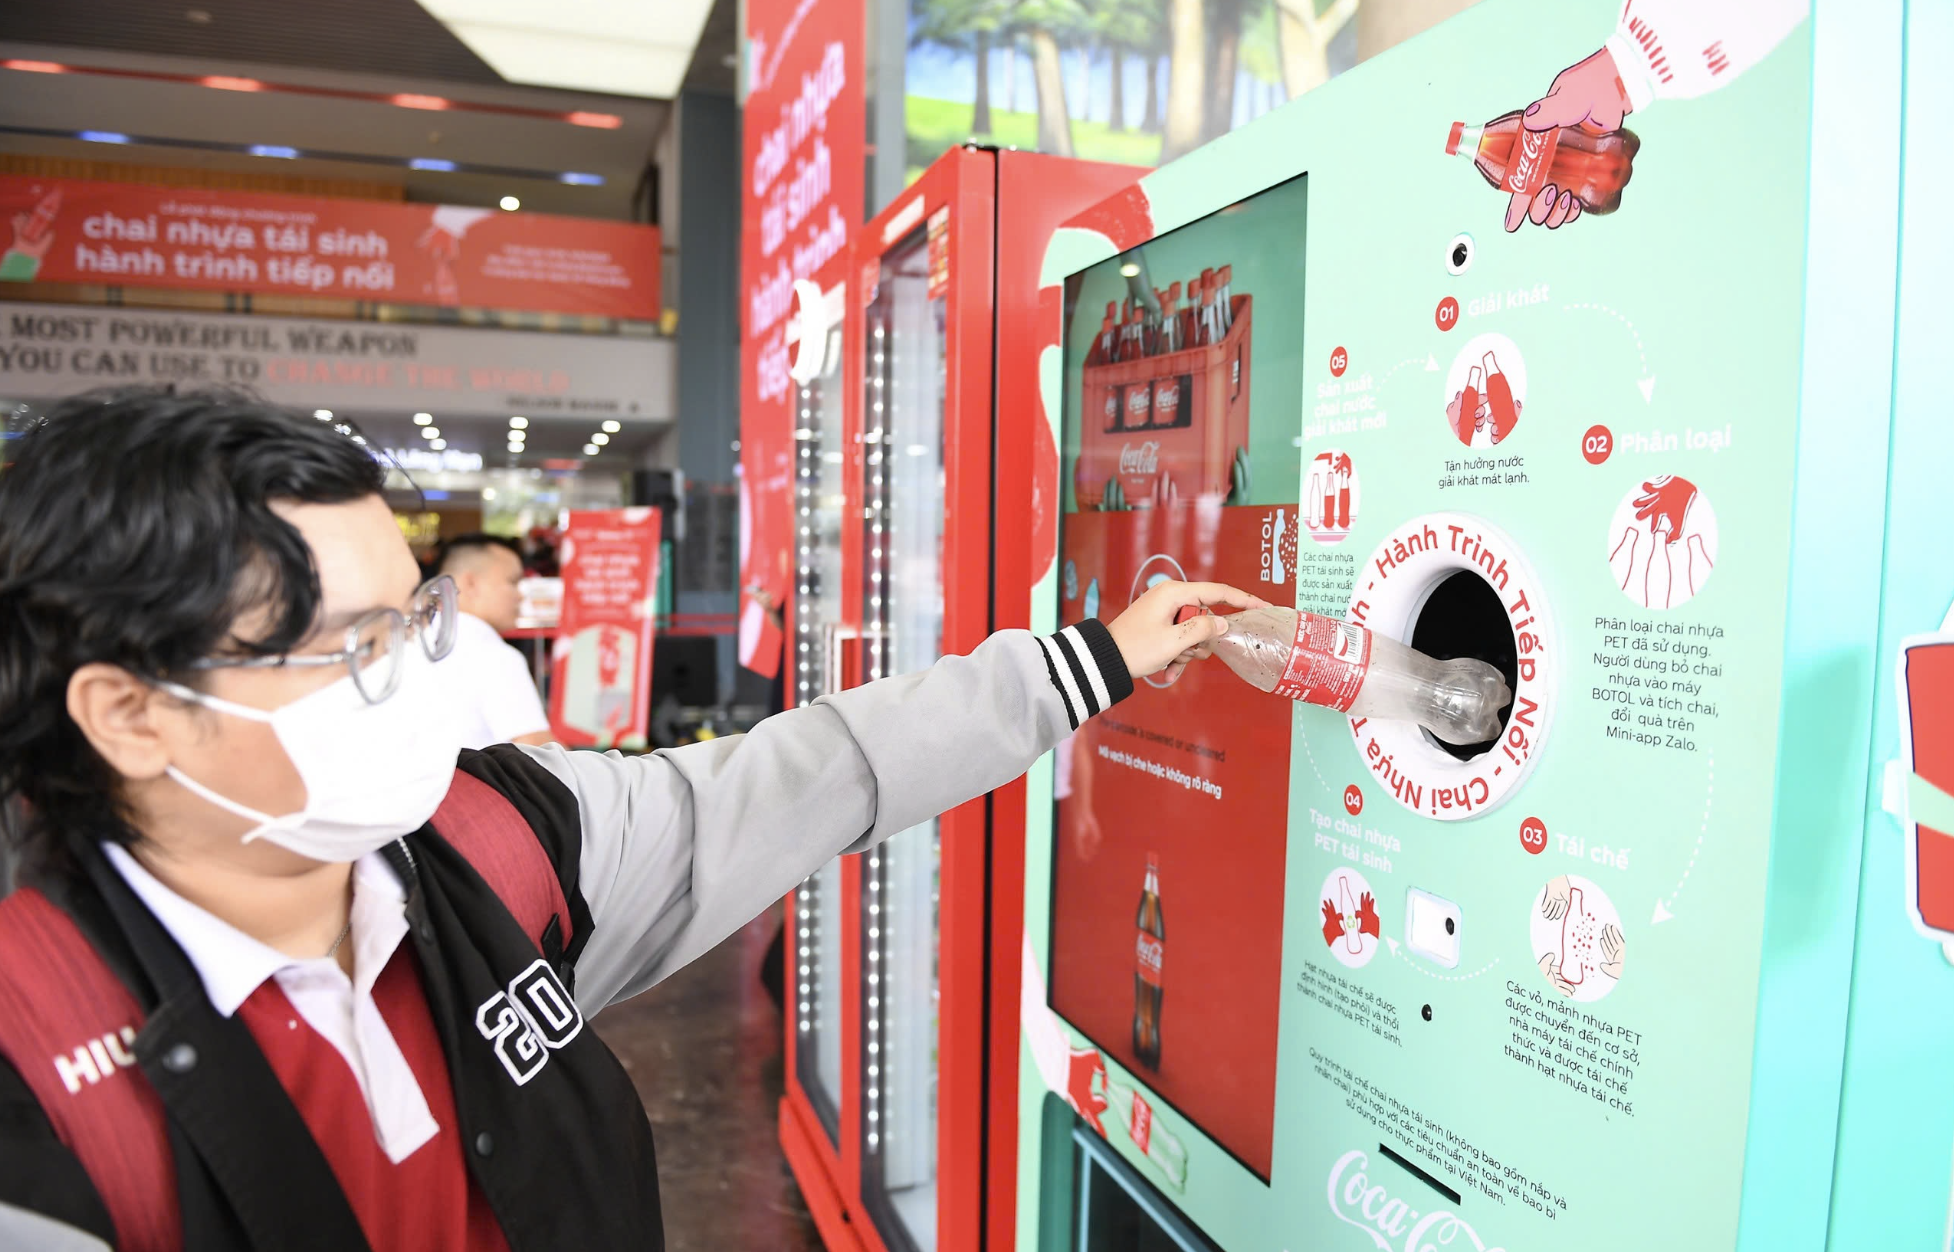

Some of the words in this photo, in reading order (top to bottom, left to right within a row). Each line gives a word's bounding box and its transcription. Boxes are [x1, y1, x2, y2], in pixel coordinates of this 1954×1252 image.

[1509, 130, 1544, 193] Coca-Co
[83, 212, 156, 241] chai
[168, 218, 255, 252] nhựa
[264, 225, 309, 252] tái
[318, 228, 388, 257] sinh
[76, 243, 165, 275] hành
[175, 249, 258, 282] trình
[267, 254, 334, 290] tiếp
[343, 259, 395, 290] nối
[1440, 306, 1453, 321] 01
[1468, 292, 1501, 316] Giải
[1507, 283, 1549, 309] khát
[11, 314, 96, 343] MOST
[109, 318, 278, 350] POWERFUL
[287, 324, 418, 355] WEAPON
[0, 346, 62, 373] YOU
[71, 353, 138, 376] CAN
[151, 356, 209, 380] USE
[222, 358, 260, 381] TO
[1332, 355, 1345, 369] 05
[1586, 435, 1607, 454] 02
[1620, 430, 1677, 454] Phân
[1686, 423, 1731, 453] loại
[1439, 475, 1454, 489] giải
[1458, 474, 1478, 486] khát
[1482, 474, 1501, 485] mát
[1505, 472, 1529, 485] lạnh.
[1445, 461, 1460, 473] Tận
[1464, 457, 1495, 470] hưởng
[1498, 456, 1524, 467] nước
[1261, 512, 1272, 582] BOTOL
[1375, 525, 1438, 579] Hành
[1448, 525, 1509, 590] Trình
[1510, 589, 1544, 682] Tiếp
[1595, 617, 1626, 630] Phân
[1630, 619, 1652, 634] loại
[1656, 622, 1684, 635] chai
[1688, 624, 1724, 639] nhựa
[1604, 636, 1628, 648] PET
[1632, 638, 1648, 650] đã
[1653, 639, 1669, 652] sử
[1672, 642, 1711, 658] dụng.
[1594, 653, 1629, 667] Người
[1634, 657, 1666, 673] dùng
[1672, 659, 1688, 673] bỏ
[1693, 663, 1722, 677] chai
[1609, 673, 1640, 688] nhựa
[1644, 676, 1667, 689] vào
[1672, 680, 1701, 696] máy
[1592, 688, 1635, 704] BOTOL
[1639, 694, 1653, 706] và
[1658, 697, 1682, 710] tích
[1688, 701, 1718, 718] chai,
[1612, 707, 1630, 722] đổi
[1638, 714, 1662, 726] quà
[1668, 717, 1694, 731] trên
[1502, 696, 1538, 766] Nối
[1606, 726, 1661, 746] Mini-app
[1666, 735, 1698, 752] Zalo.
[1367, 738, 1423, 809] Nhựa
[1432, 776, 1489, 815] Chai
[1346, 792, 1360, 808] 04
[1310, 808, 1332, 829] Tạo
[1335, 818, 1361, 838] chai
[1365, 829, 1400, 852] nhựa
[1523, 827, 1543, 845] 03
[1555, 832, 1584, 858] Tái
[1591, 844, 1631, 870] chế
[1315, 832, 1339, 853] PET
[1342, 843, 1359, 861] tái
[1363, 851, 1392, 873] sinh
[476, 958, 584, 1086] 20
[1506, 997, 1532, 1016] được
[1535, 1011, 1575, 1035] chuyển
[1579, 1029, 1600, 1047] đến
[1605, 1042, 1619, 1055] cơ
[1623, 1048, 1640, 1066] sở,
[1507, 980, 1526, 997] Các
[1529, 991, 1543, 1007] vỏ,
[1547, 999, 1579, 1020] mảnh
[1583, 1014, 1613, 1034] nhựa
[1617, 1026, 1642, 1045] PET
[1510, 1016, 1528, 1031] nhà
[1532, 1027, 1555, 1044] máy
[1559, 1037, 1572, 1051] tái
[1576, 1047, 1597, 1063] chế
[1600, 1057, 1633, 1079] chính
[1513, 1032, 1535, 1052] thức
[1539, 1047, 1551, 1059] và
[1555, 1053, 1583, 1074] được
[1587, 1067, 1601, 1083] tái
[1605, 1078, 1627, 1095] chế
[1505, 1045, 1534, 1067] thành
[1538, 1060, 1555, 1079] hạt
[1559, 1073, 1588, 1094] nhựa
[1592, 1087, 1606, 1103] tái
[1609, 1098, 1634, 1117] chế.
[1309, 1047, 1323, 1063] Quy
[1325, 1057, 1342, 1074] trình
[1343, 1068, 1353, 1081] tái
[1354, 1076, 1369, 1091] chế
[1370, 1086, 1387, 1102] chai
[1389, 1097, 1409, 1116] nhựa
[1411, 1110, 1423, 1124] tái
[1425, 1119, 1443, 1136] sinh
[1446, 1129, 1479, 1159] (không
[1482, 1151, 1501, 1170] bao
[1504, 1167, 1527, 1186] gồm
[1531, 1182, 1551, 1201] nắp
[1554, 1195, 1567, 1210] và
[1314, 1065, 1332, 1081] nhãn
[1333, 1076, 1351, 1094] chai)
[1352, 1089, 1367, 1104] phù
[1369, 1098, 1385, 1115] hợp
[1386, 1110, 1398, 1124] với
[1400, 1119, 1415, 1134] các
[1417, 1129, 1434, 1146] tiêu
[1436, 1141, 1465, 1164] chuẩn
[1467, 1160, 1479, 1173] an
[1482, 1168, 1505, 1189] toàn
[1507, 1184, 1520, 1197] về
[1522, 1191, 1543, 1212] bao
[1546, 1205, 1556, 1220] bì
[1346, 1098, 1355, 1110] sử
[1357, 1105, 1377, 1125] dụng
[1378, 1119, 1393, 1135] cho
[1395, 1129, 1414, 1148] thực
[1416, 1144, 1442, 1166] phẩm
[1444, 1160, 1456, 1175] tại
[1459, 1167, 1477, 1189] Việt
[1480, 1181, 1506, 1206] Nam.
[1327, 1150, 1506, 1252] Coca-C
